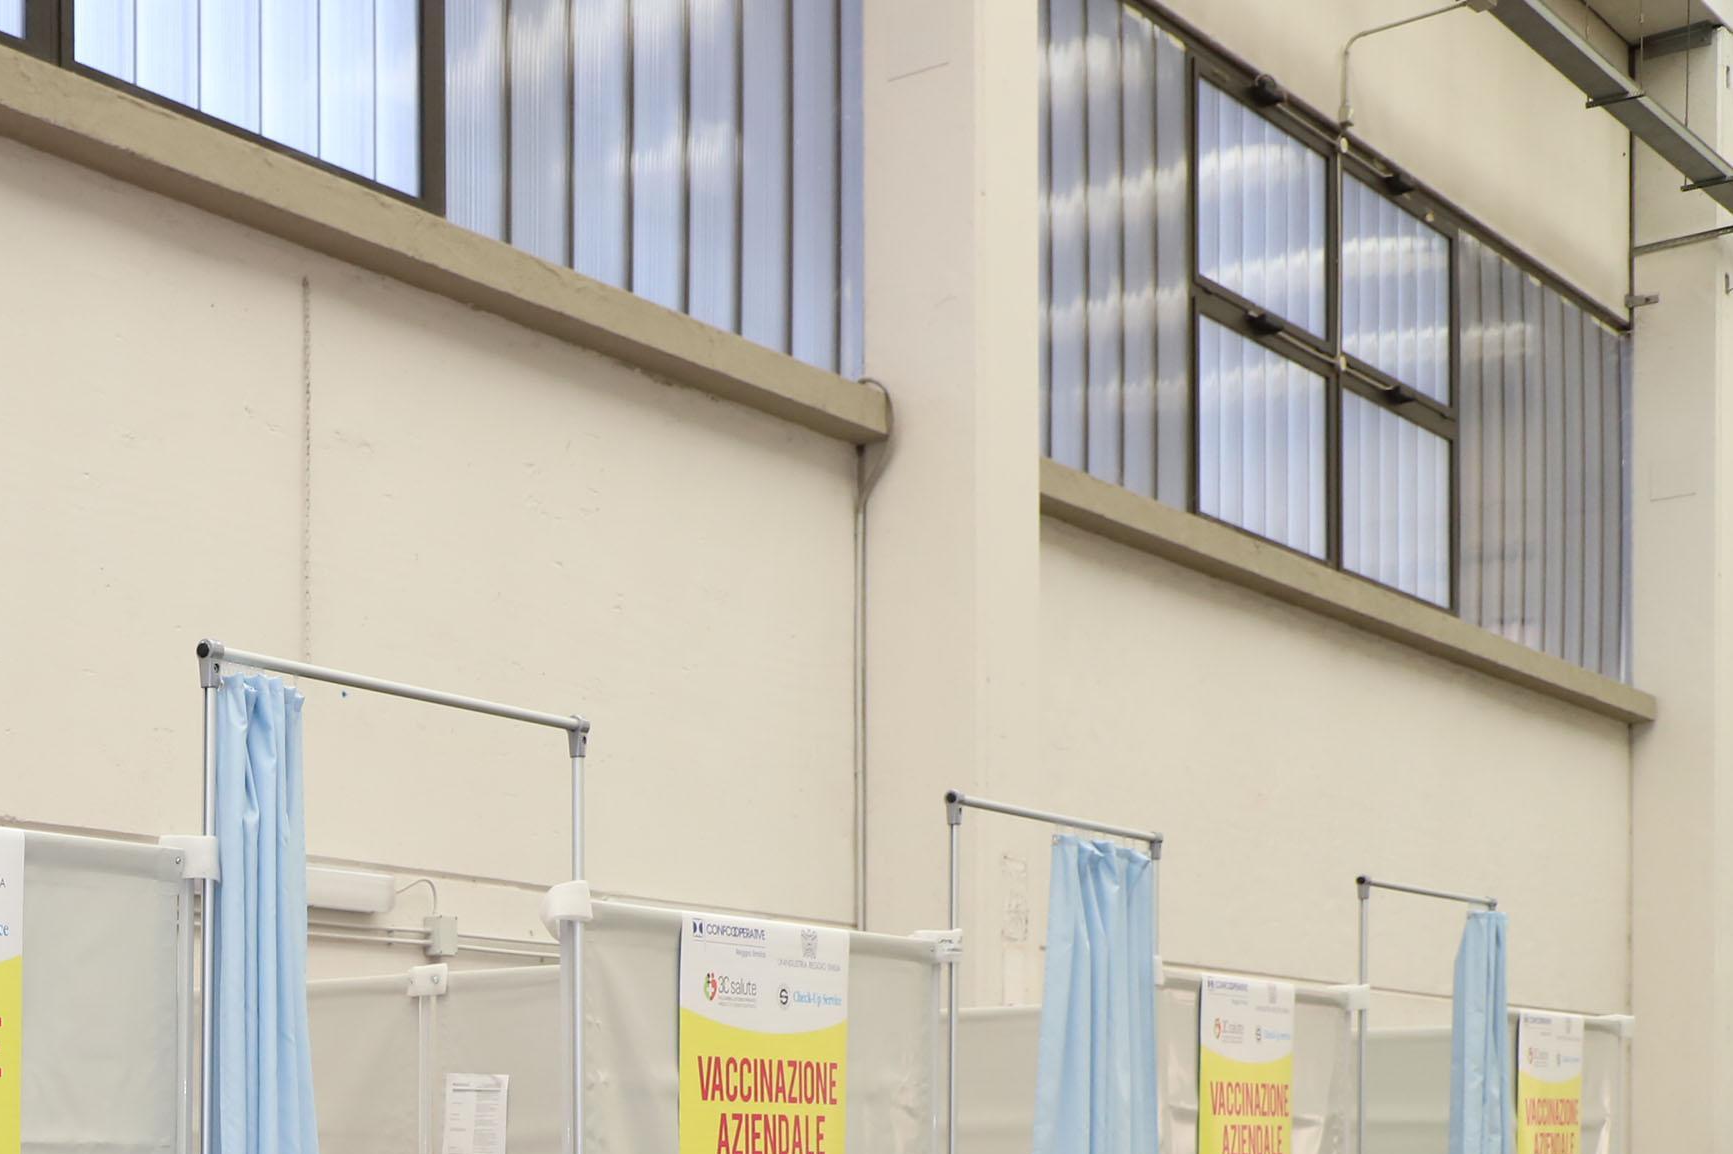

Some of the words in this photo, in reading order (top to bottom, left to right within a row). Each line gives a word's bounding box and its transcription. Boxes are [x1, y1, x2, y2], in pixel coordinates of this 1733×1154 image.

[717, 975, 730, 994] 3C
[731, 978, 757, 996] salute
[697, 1055, 838, 1105] VACCINAZIONE
[1210, 1080, 1289, 1117] VACCINAZIONE
